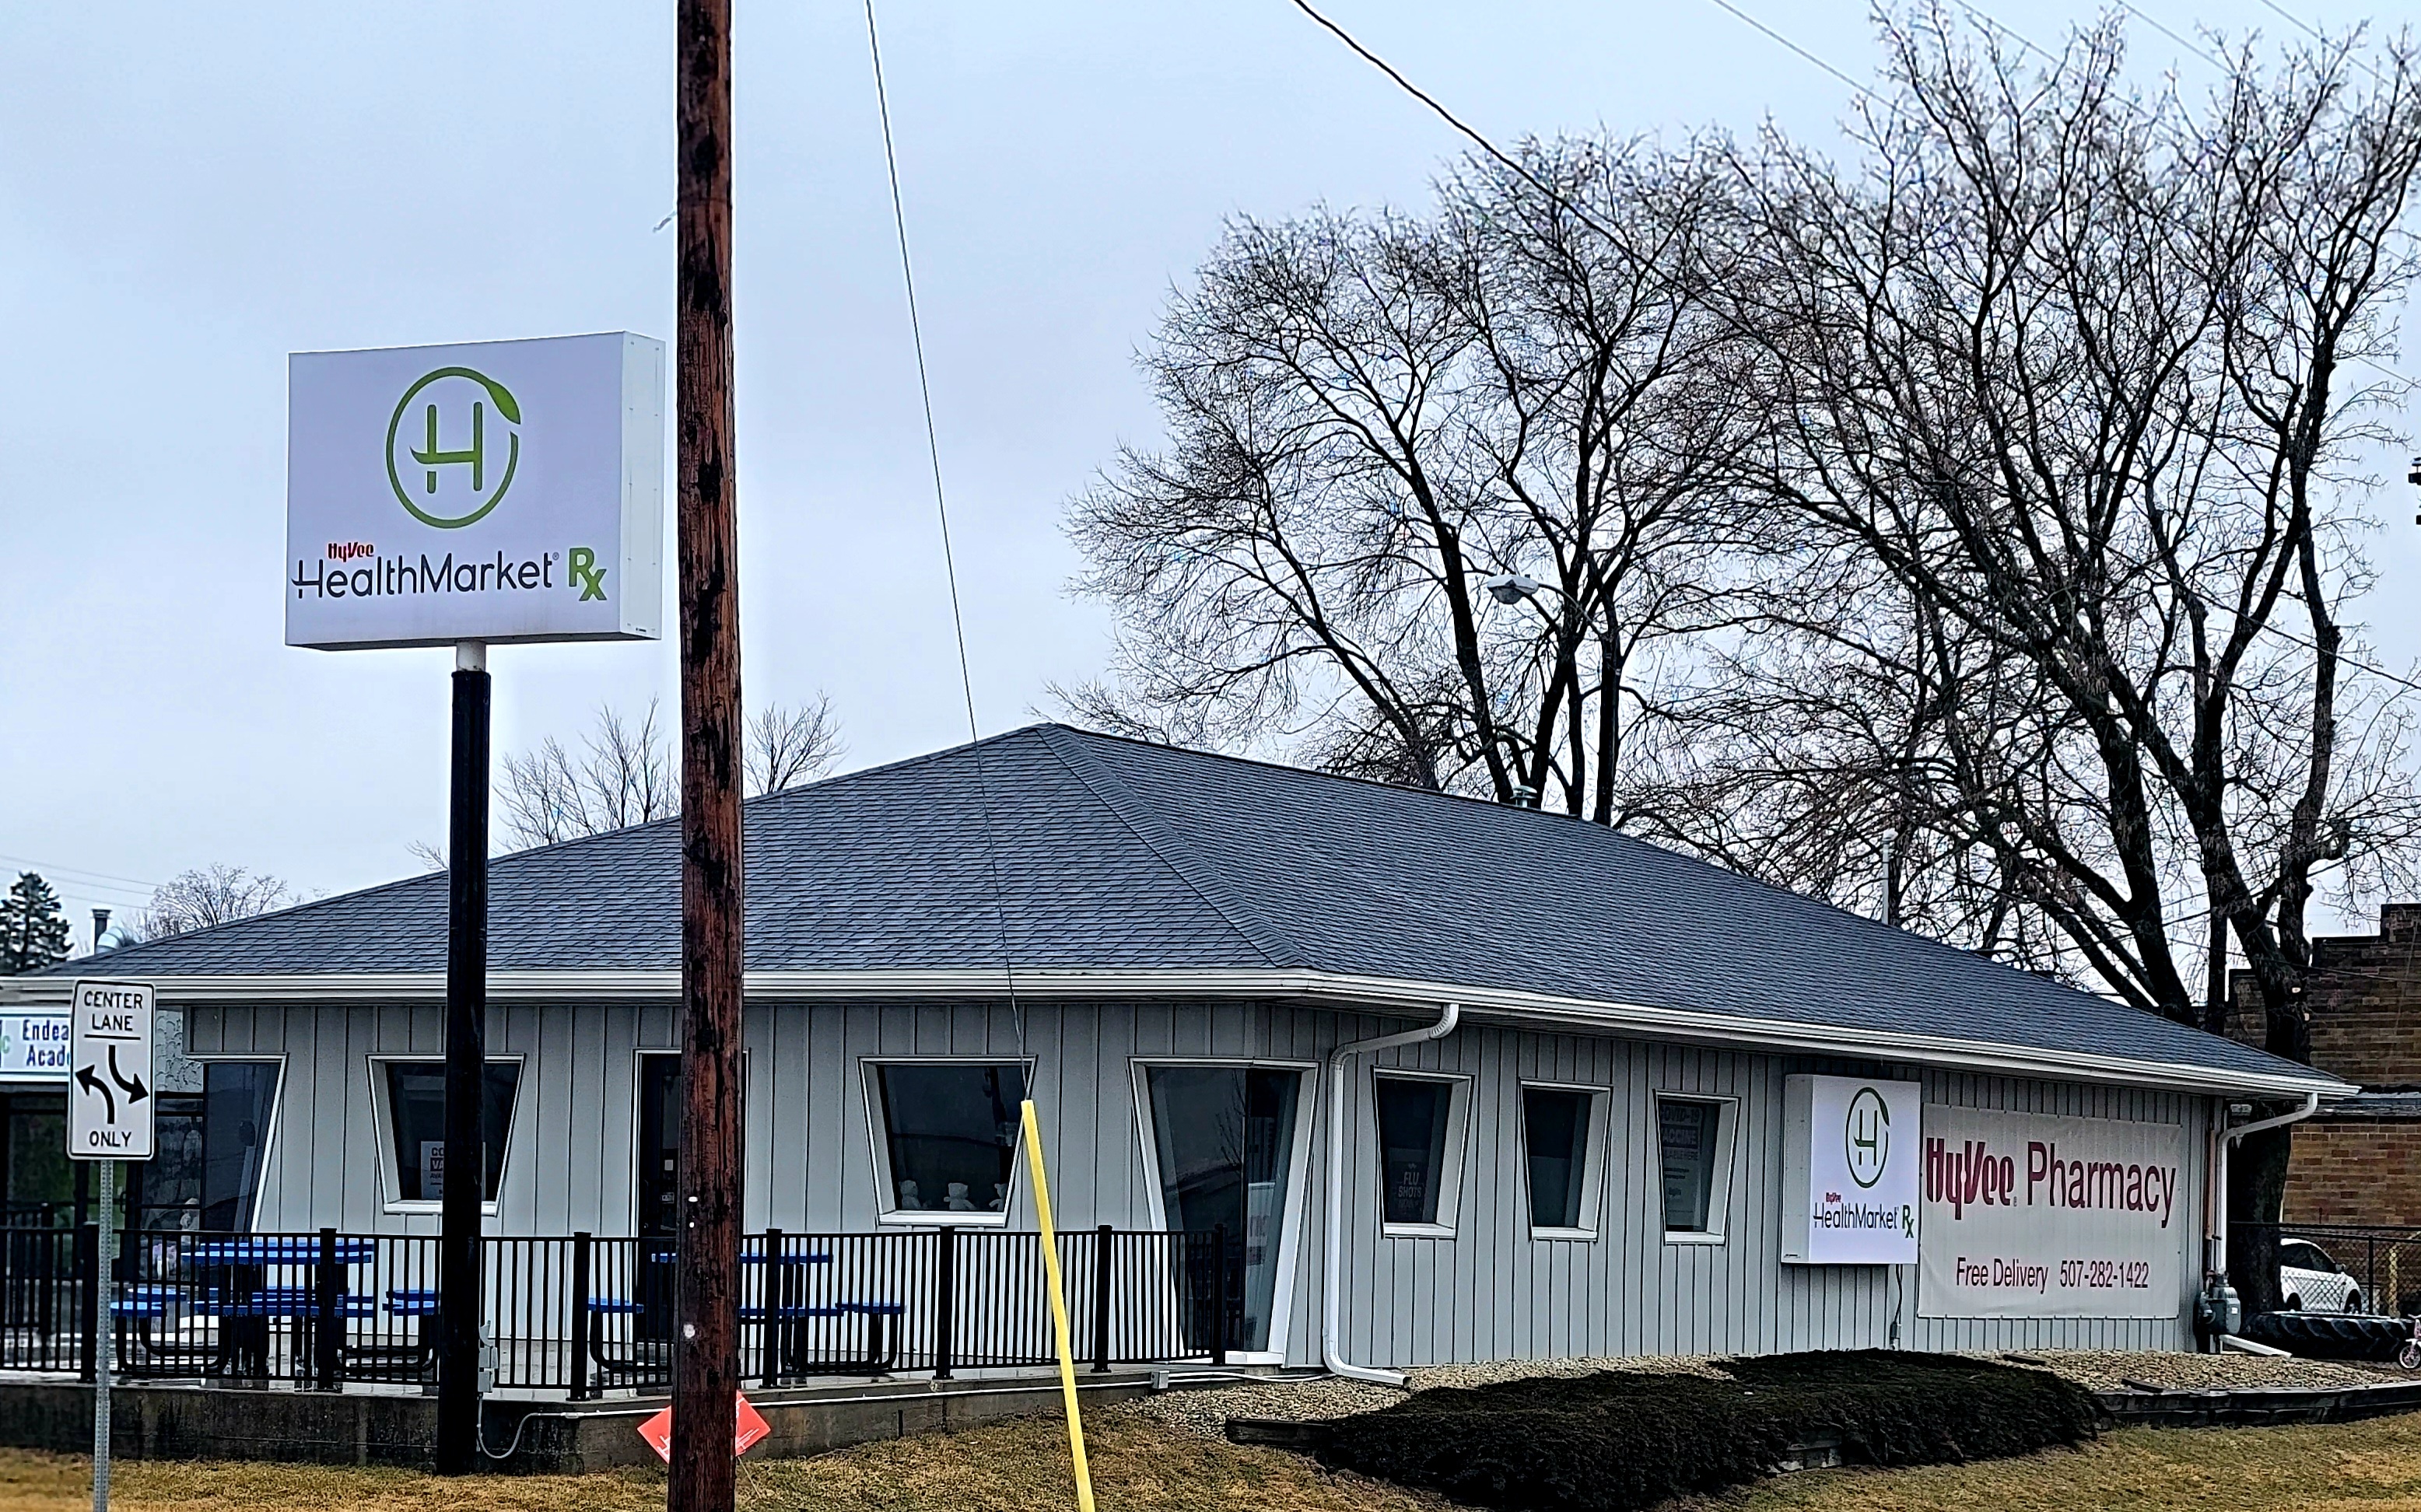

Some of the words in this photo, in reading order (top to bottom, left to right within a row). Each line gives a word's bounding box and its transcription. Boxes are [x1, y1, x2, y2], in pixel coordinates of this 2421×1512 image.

[328, 542, 374, 562] HyVee
[569, 547, 608, 602] Rx
[84, 990, 143, 1010] CENTER
[23, 1019, 69, 1041] Endea
[91, 1013, 133, 1032] LANE
[89, 1130, 132, 1147] ONLY
[1403, 1171, 1420, 1185] FLU
[1925, 1136, 2016, 1221] HyVee
[2027, 1141, 2177, 1228] Pharmacy
[1397, 1185, 1422, 1198] SHOTS
[1902, 1204, 1915, 1238] Rx
[1956, 1257, 1988, 1286] Free
[1993, 1258, 2048, 1295] Delivery
[2059, 1259, 2149, 1289] 507-282-1422
